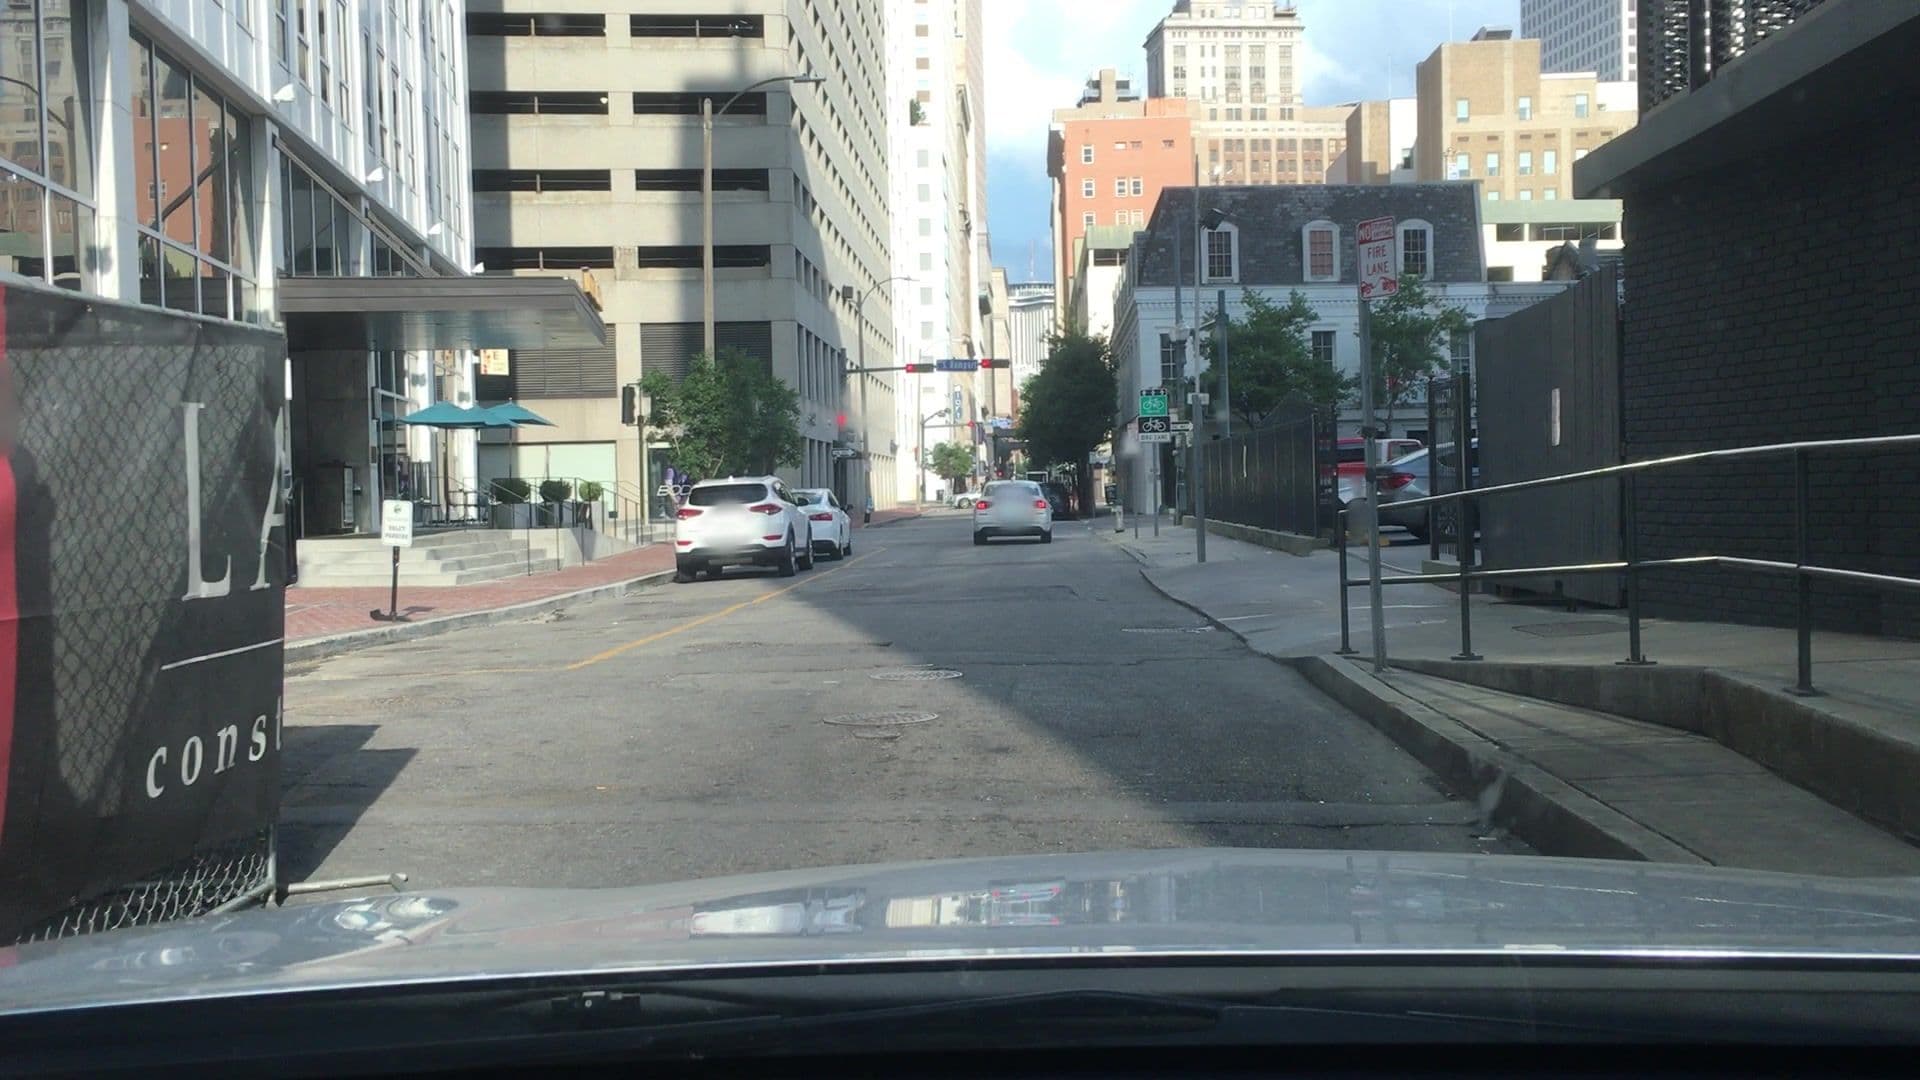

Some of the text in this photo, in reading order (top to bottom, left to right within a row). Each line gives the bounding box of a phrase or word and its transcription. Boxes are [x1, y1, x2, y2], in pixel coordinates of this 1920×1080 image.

[1360, 224, 1371, 241] NO
[1368, 244, 1387, 259] FIRE
[1367, 261, 1389, 276] LANE
